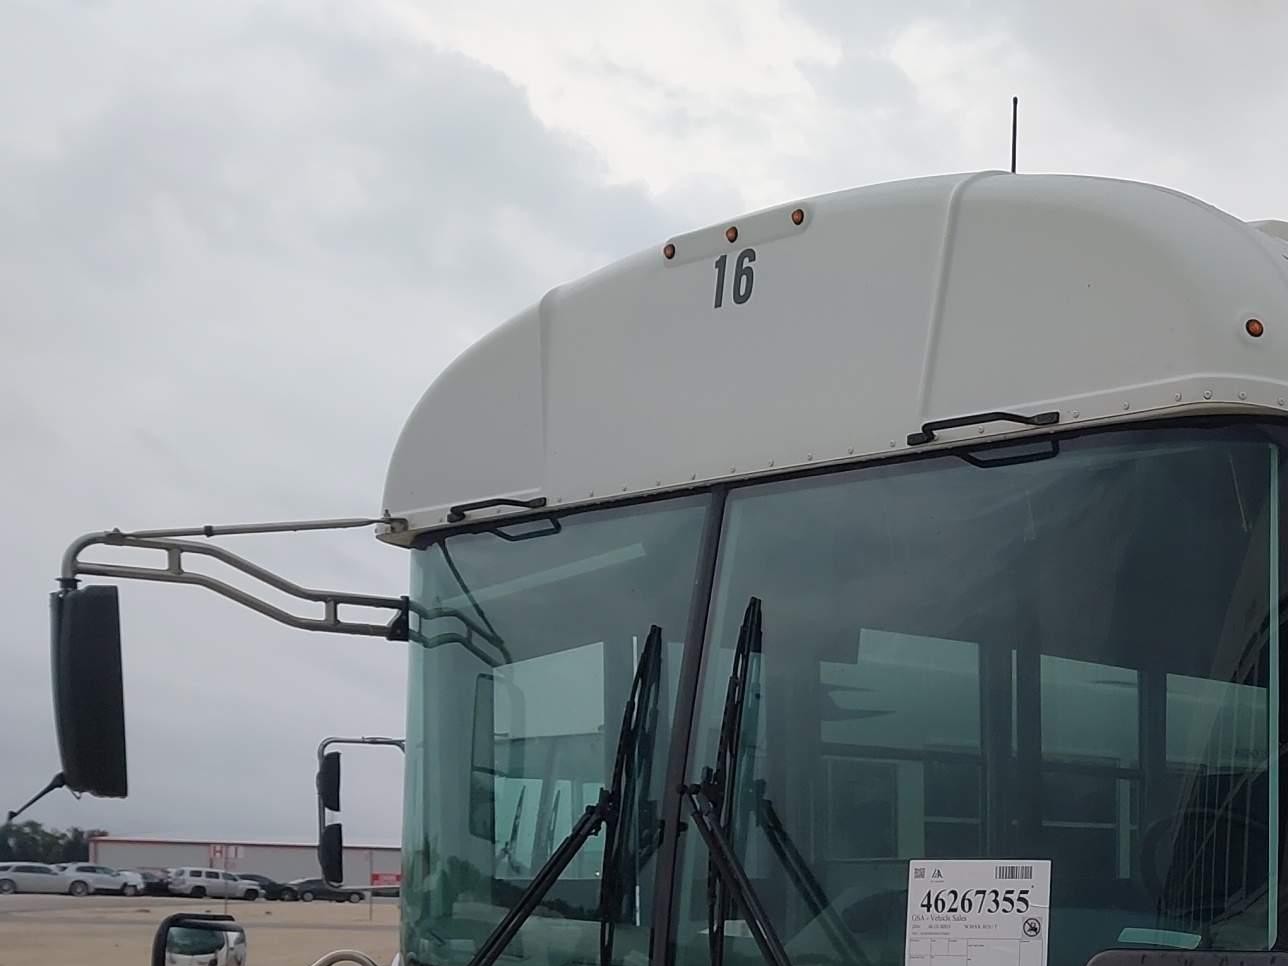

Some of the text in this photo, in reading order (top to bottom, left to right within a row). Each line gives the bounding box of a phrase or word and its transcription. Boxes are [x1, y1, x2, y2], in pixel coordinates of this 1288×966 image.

[714, 248, 756, 308] 16
[920, 889, 1029, 913] 46267355
[930, 914, 951, 922] Vehicle
[951, 914, 967, 922] Sales
